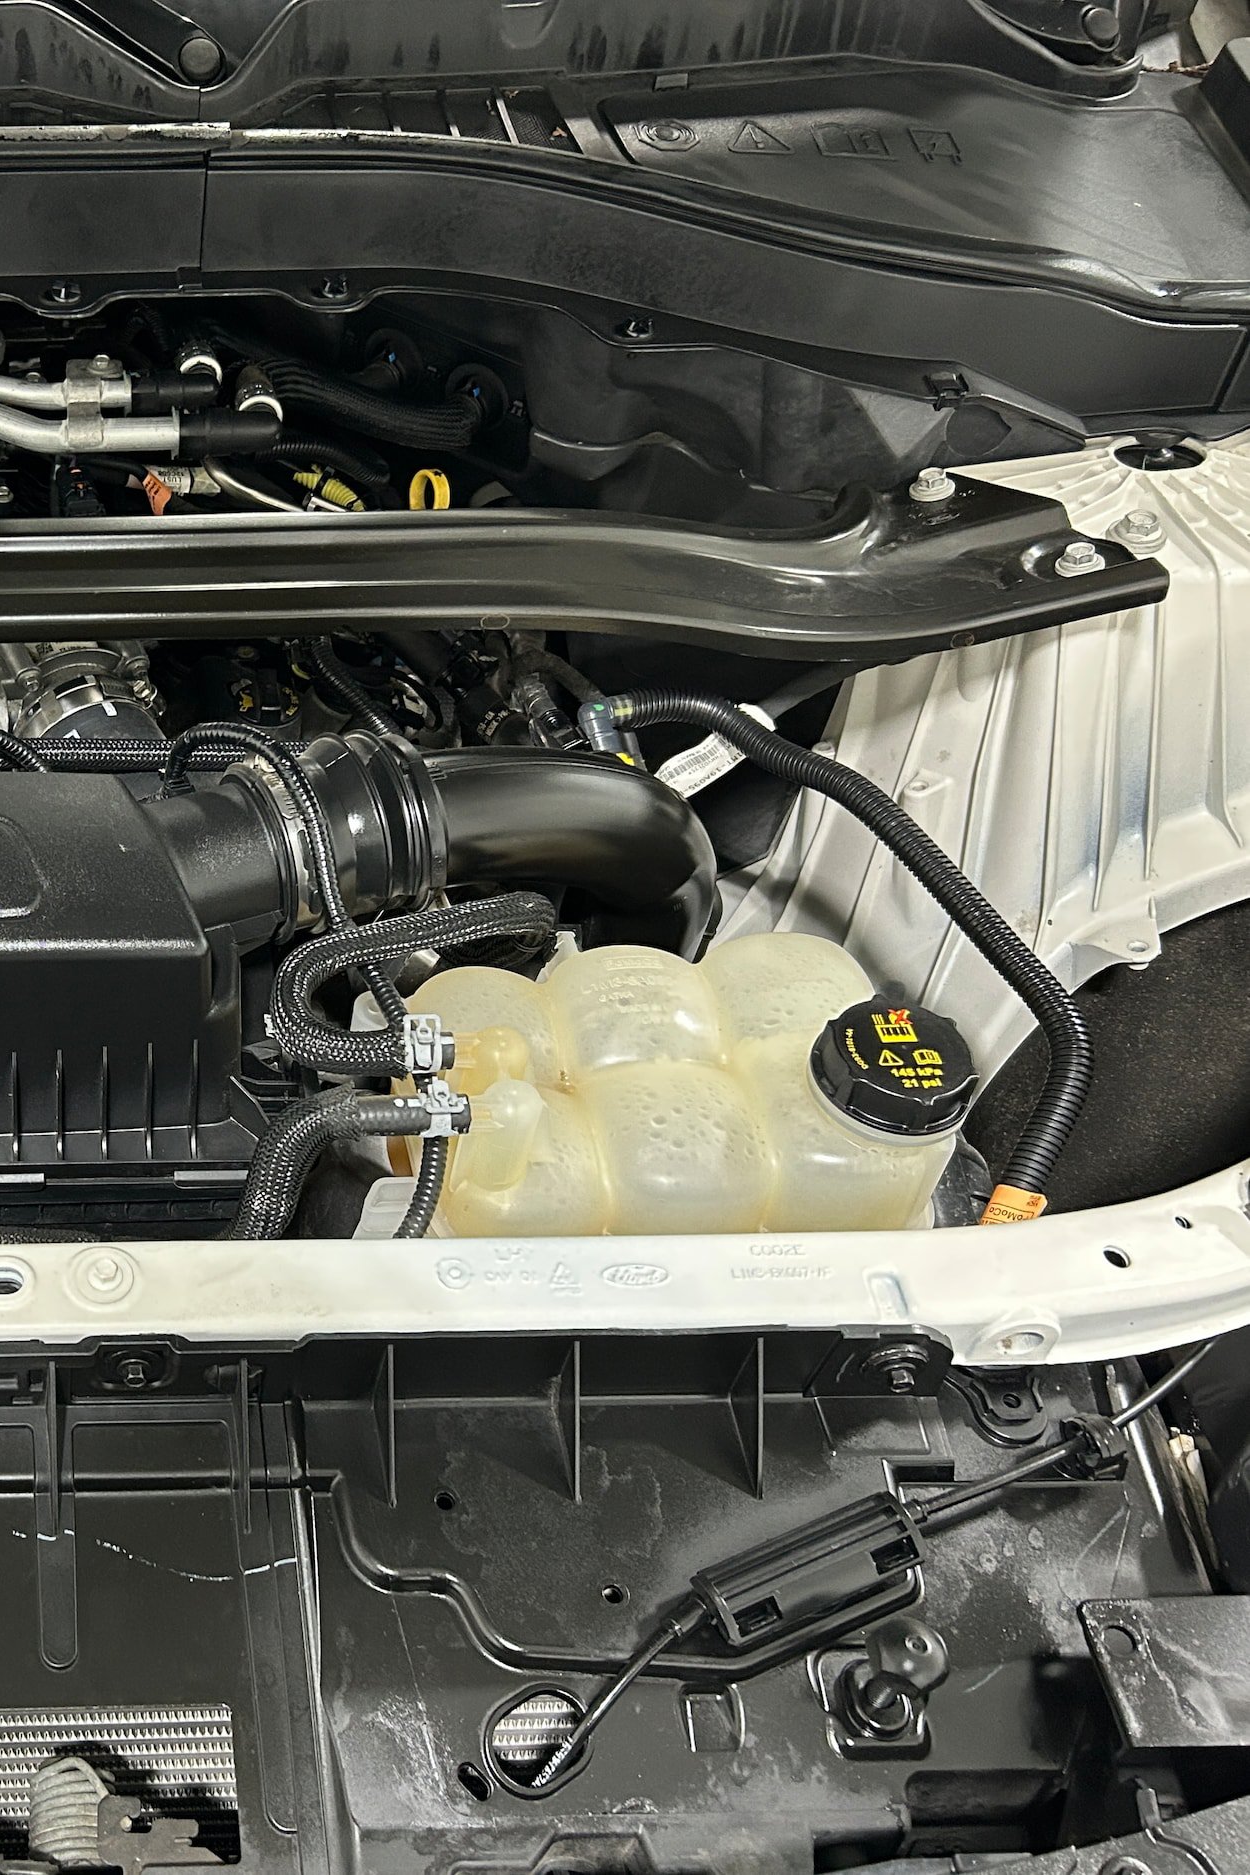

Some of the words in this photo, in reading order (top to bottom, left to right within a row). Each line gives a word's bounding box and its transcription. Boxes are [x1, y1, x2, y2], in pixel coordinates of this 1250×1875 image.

[890, 1068, 914, 1078] 145
[917, 1068, 944, 1076] kPa
[902, 1078, 918, 1088] 21
[922, 1078, 942, 1088] psi
